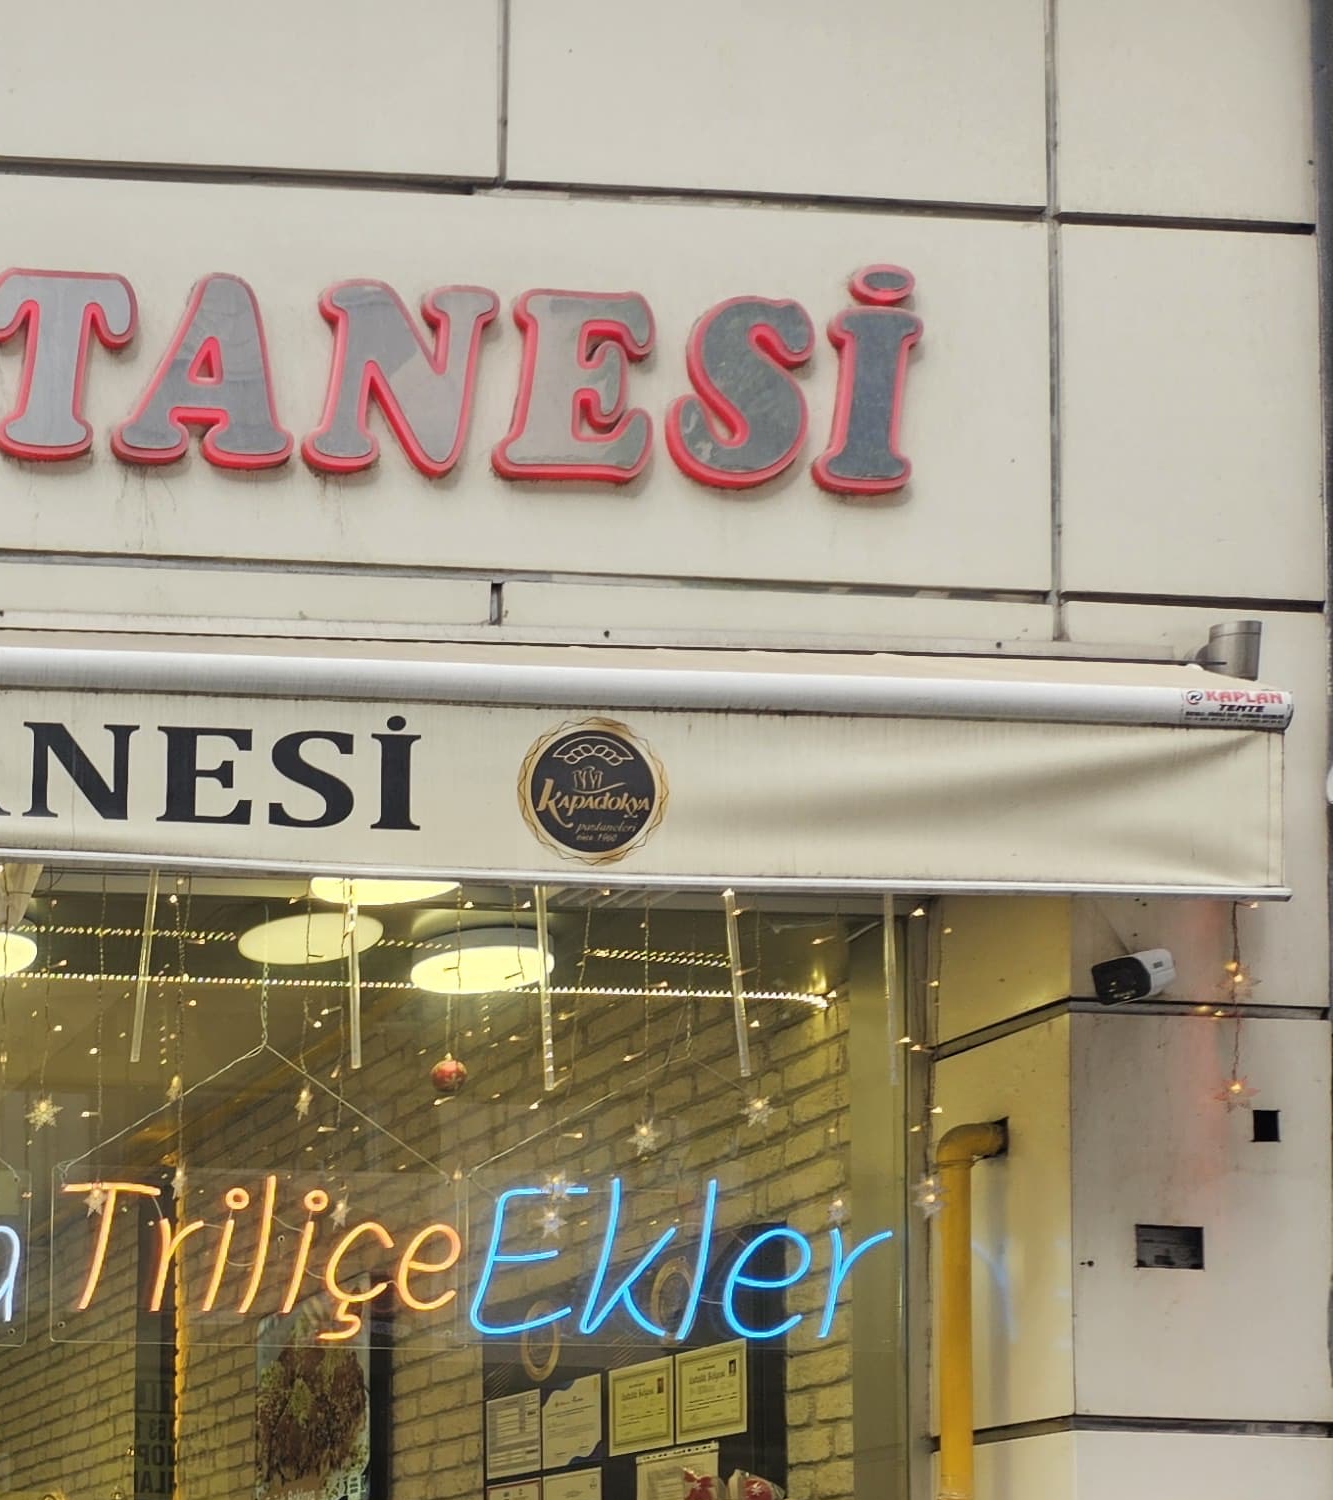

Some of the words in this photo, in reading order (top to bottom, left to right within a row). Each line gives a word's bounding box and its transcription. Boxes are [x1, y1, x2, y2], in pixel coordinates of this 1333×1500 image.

[1205, 690, 1283, 704] KAPLAN
[61, 1174, 462, 1341] Triliçe
[470, 1177, 894, 1339] Ekler
